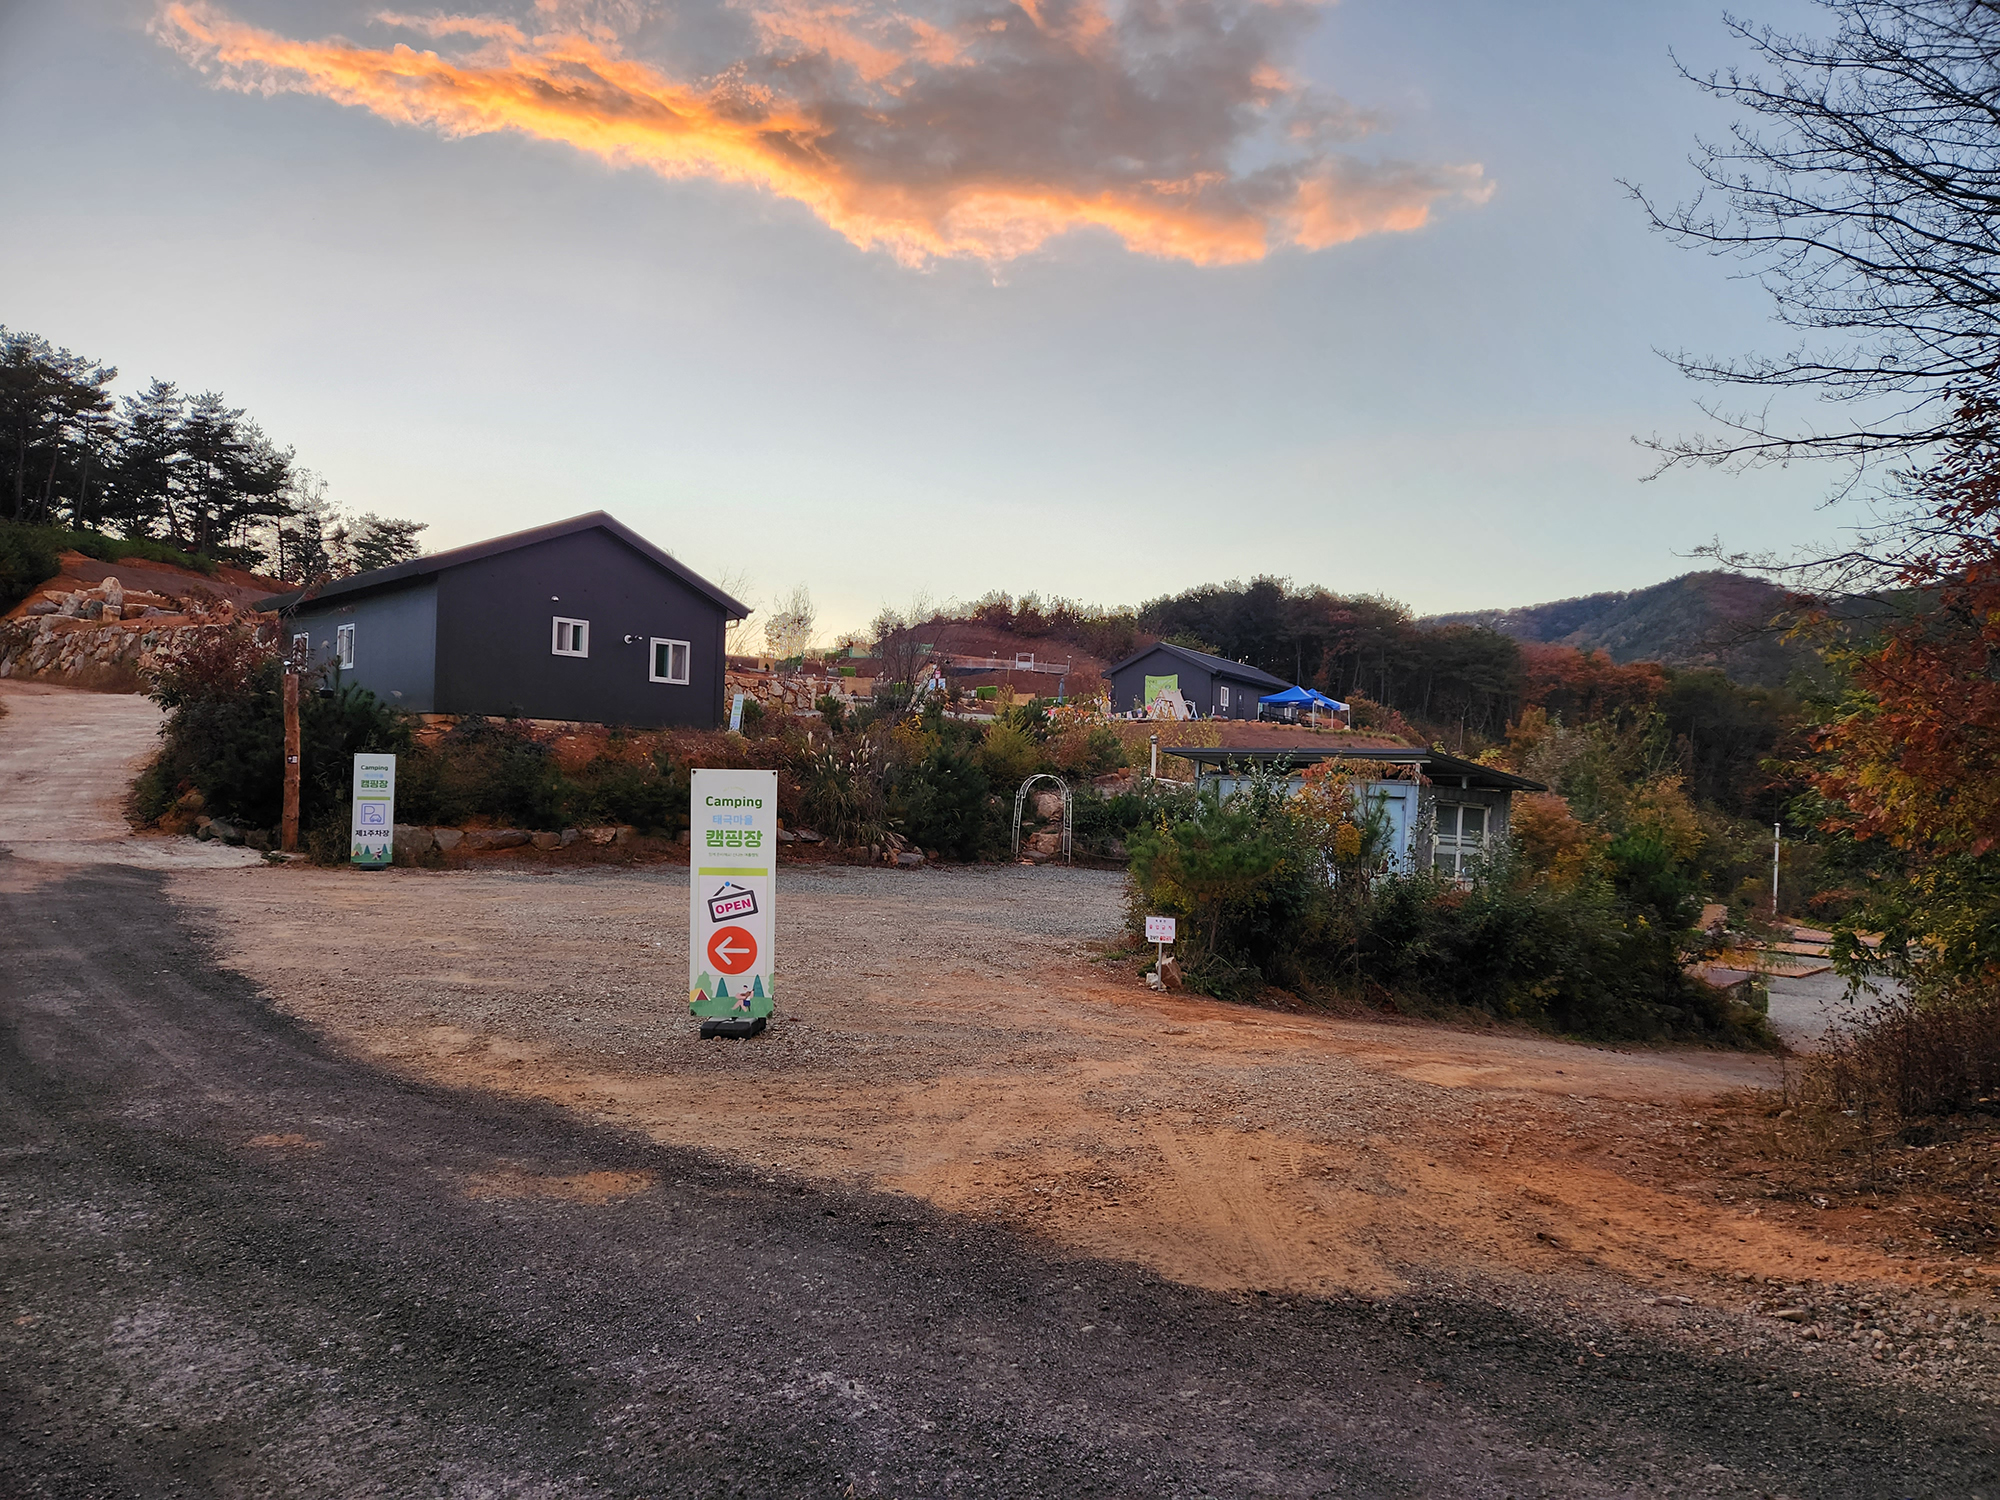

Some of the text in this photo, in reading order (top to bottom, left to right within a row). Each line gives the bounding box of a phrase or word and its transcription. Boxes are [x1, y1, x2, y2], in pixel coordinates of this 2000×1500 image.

[706, 796, 763, 808] Camping
[712, 814, 753, 825] 태극마을
[355, 829, 389, 837] 제1주차장
[706, 829, 763, 847] 캠핑장
[715, 899, 751, 914] OPEN
